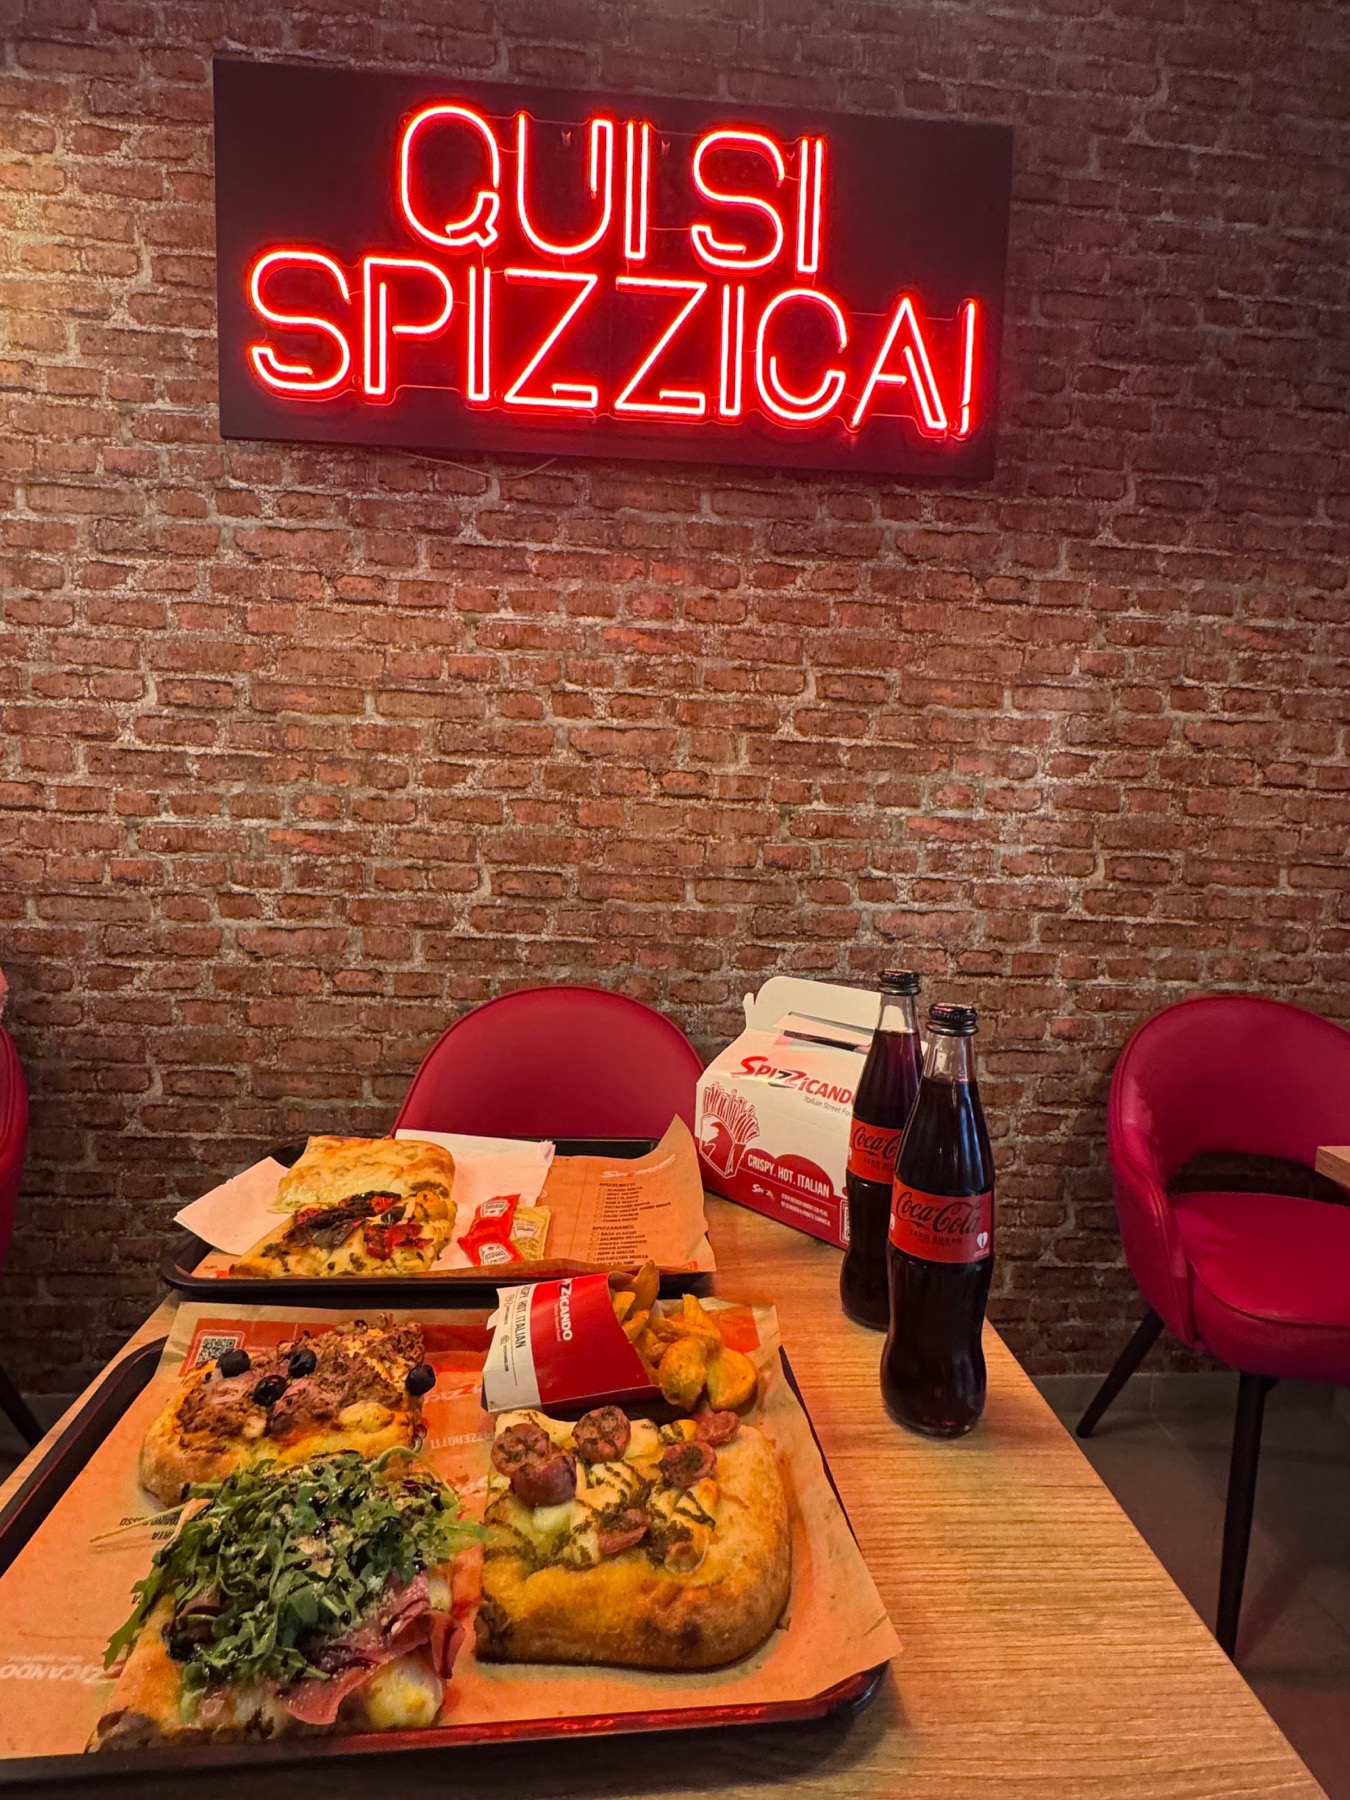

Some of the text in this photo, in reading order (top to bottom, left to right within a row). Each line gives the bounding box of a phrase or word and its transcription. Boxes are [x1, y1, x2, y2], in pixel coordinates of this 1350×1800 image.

[398, 102, 828, 275] QUI SI
[803, 1095, 823, 1107] Italian
[823, 1099, 841, 1114] Street
[853, 1126, 902, 1160] Coca-C
[797, 1173, 830, 1198] ITALIAN
[895, 1191, 984, 1235] Coca-Cola
[515, 1315, 527, 1349] ITALIAN
